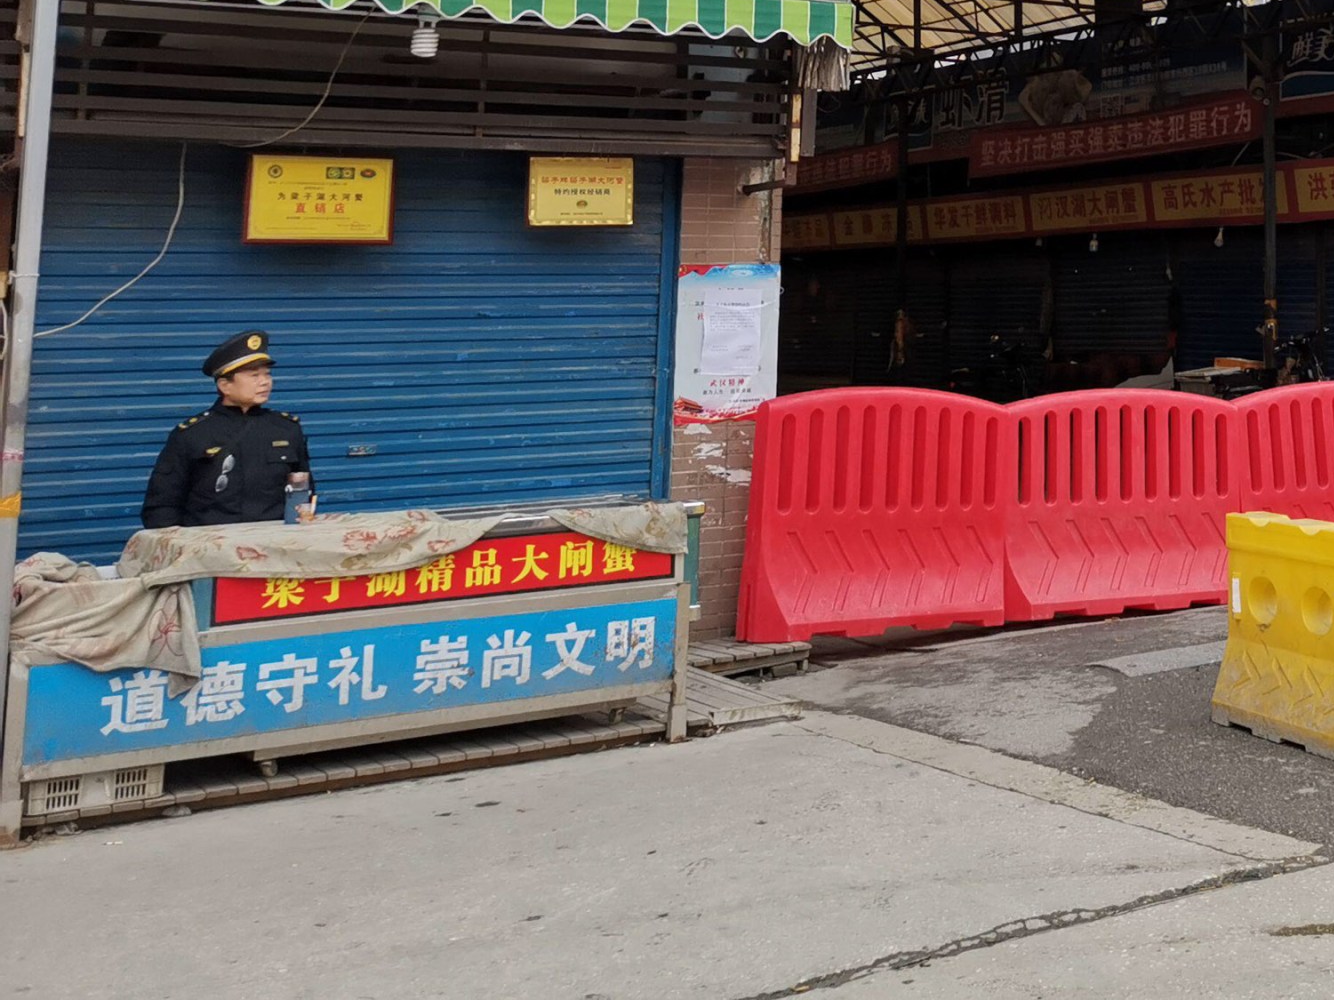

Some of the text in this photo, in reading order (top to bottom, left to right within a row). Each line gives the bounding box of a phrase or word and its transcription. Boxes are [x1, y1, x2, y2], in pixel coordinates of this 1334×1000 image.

[980, 101, 1253, 167] 坚决打击强买强卖违法犯罪行为
[100, 615, 656, 737] 道德守礼 崇尚文明
